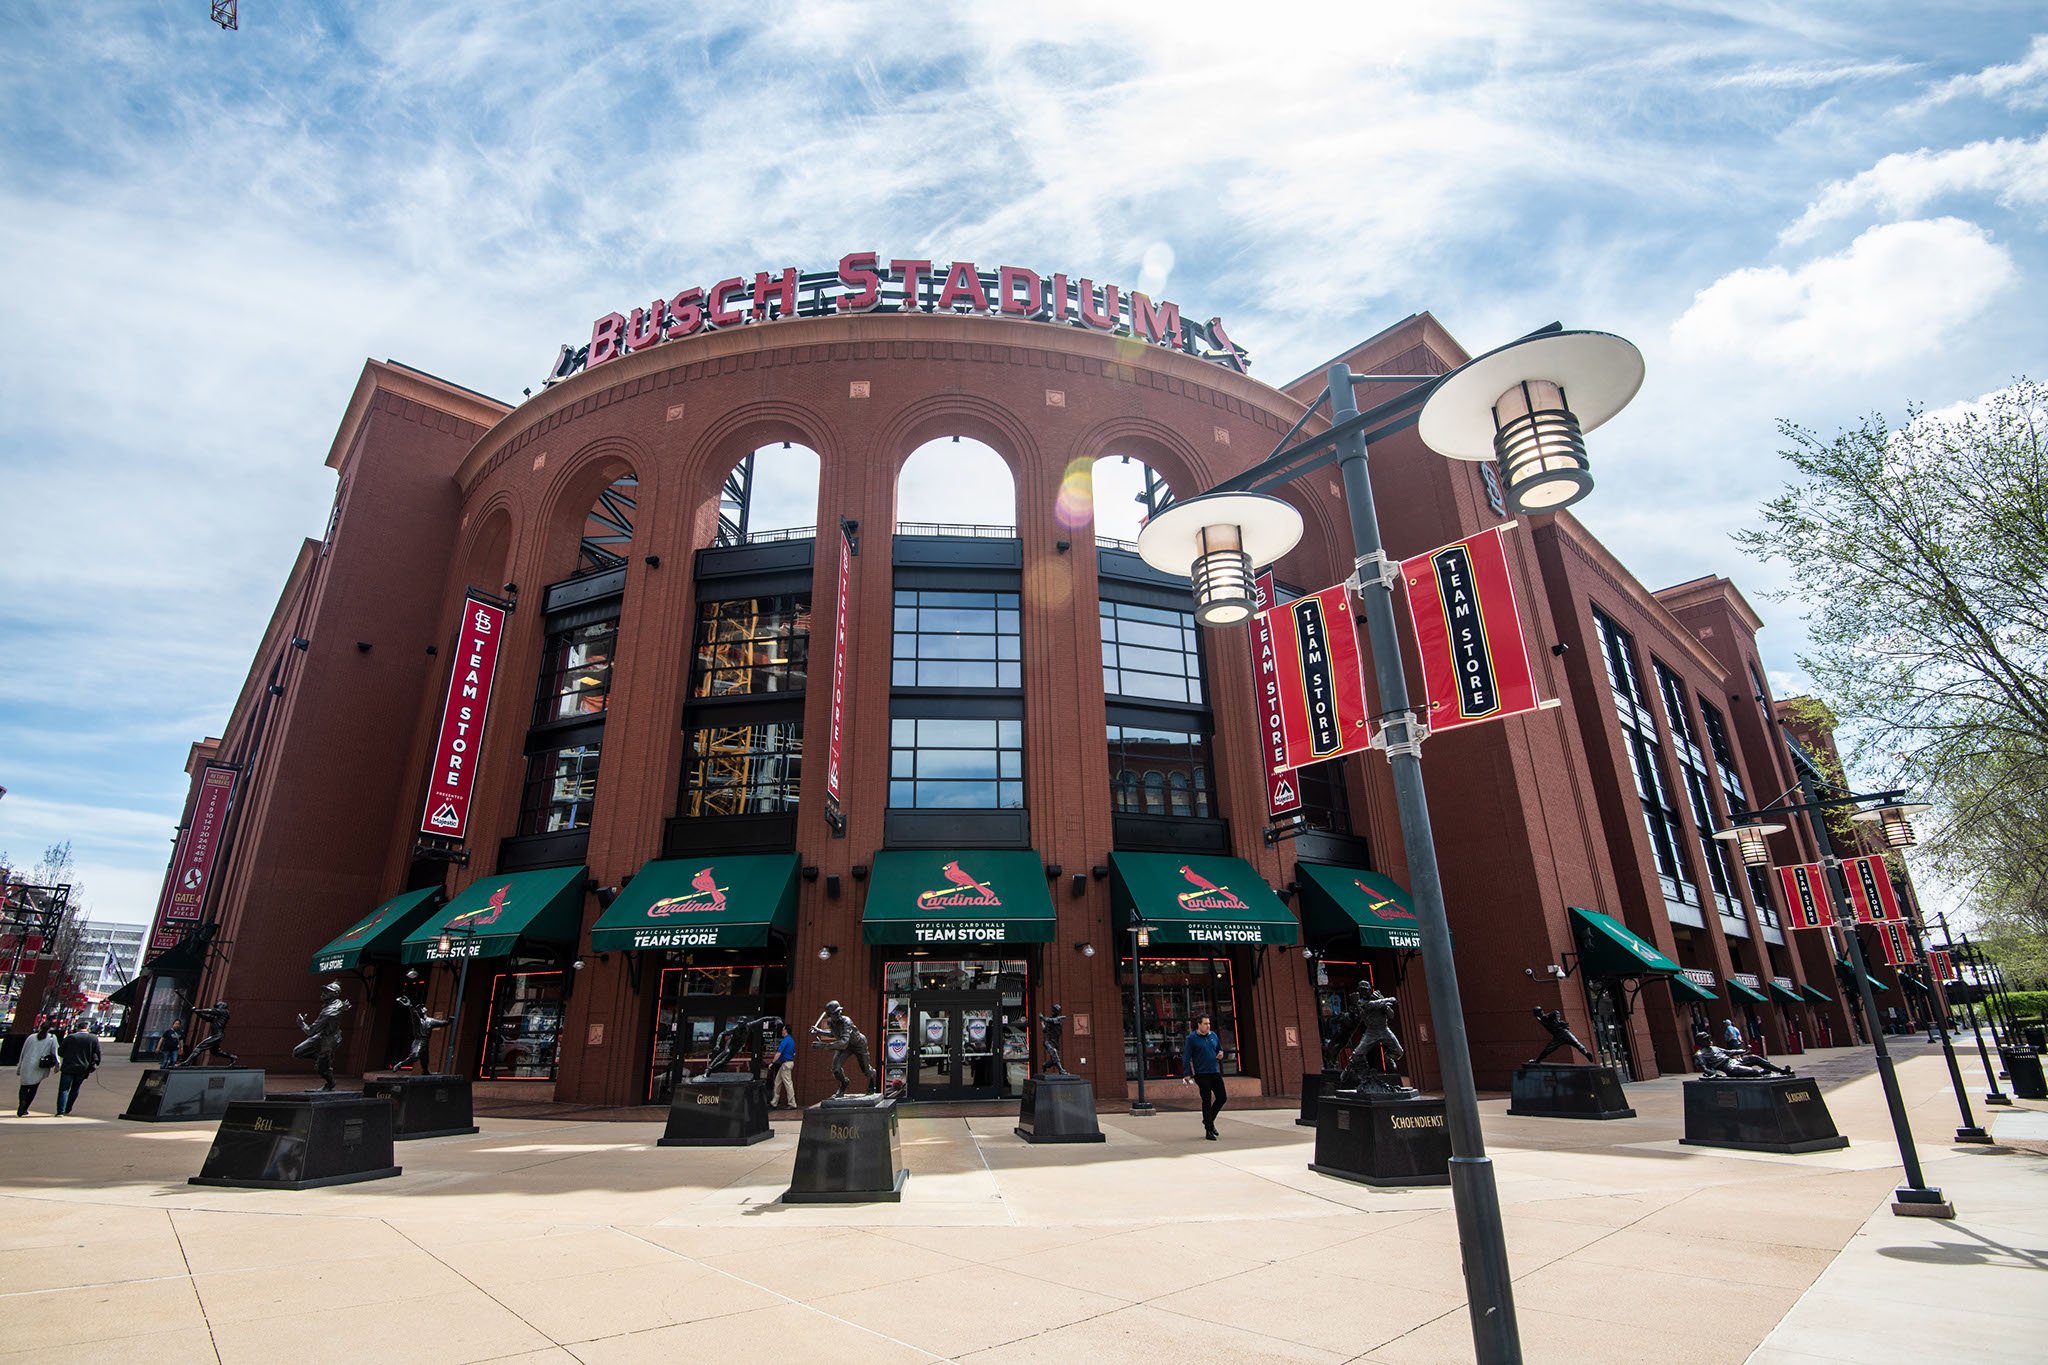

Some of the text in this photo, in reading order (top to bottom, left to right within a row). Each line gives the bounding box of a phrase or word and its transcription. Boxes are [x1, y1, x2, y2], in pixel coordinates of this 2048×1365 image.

[587, 252, 1184, 369] BUSCH STADIUM
[1445, 558, 1484, 705] TEAM STORE
[1303, 609, 1330, 745] TEAM STORE
[446, 638, 485, 786] TEAM STORE
[1267, 682, 1284, 762] STORE
[436, 791, 464, 800] PRESENTED
[432, 817, 457, 827] Majestic
[1797, 870, 1815, 922] TEAM STORE
[1861, 862, 1880, 917] TEAM STORE
[175, 893, 202, 903] GATE 4
[917, 890, 1002, 910] Cardinals
[1177, 892, 1249, 912] Cardinals
[647, 898, 727, 917] Cardinals
[634, 934, 717, 947] TEAM STORE
[916, 929, 1005, 941] TEAM STORE
[1188, 930, 1262, 941] TEAM STORE
[1389, 936, 1412, 947] TEAM
[697, 1094, 719, 1105] GIBSON
[254, 1116, 274, 1131] BELL
[1390, 1115, 1444, 1129] SCHOENDIENST
[830, 1124, 860, 1139] BROCK
